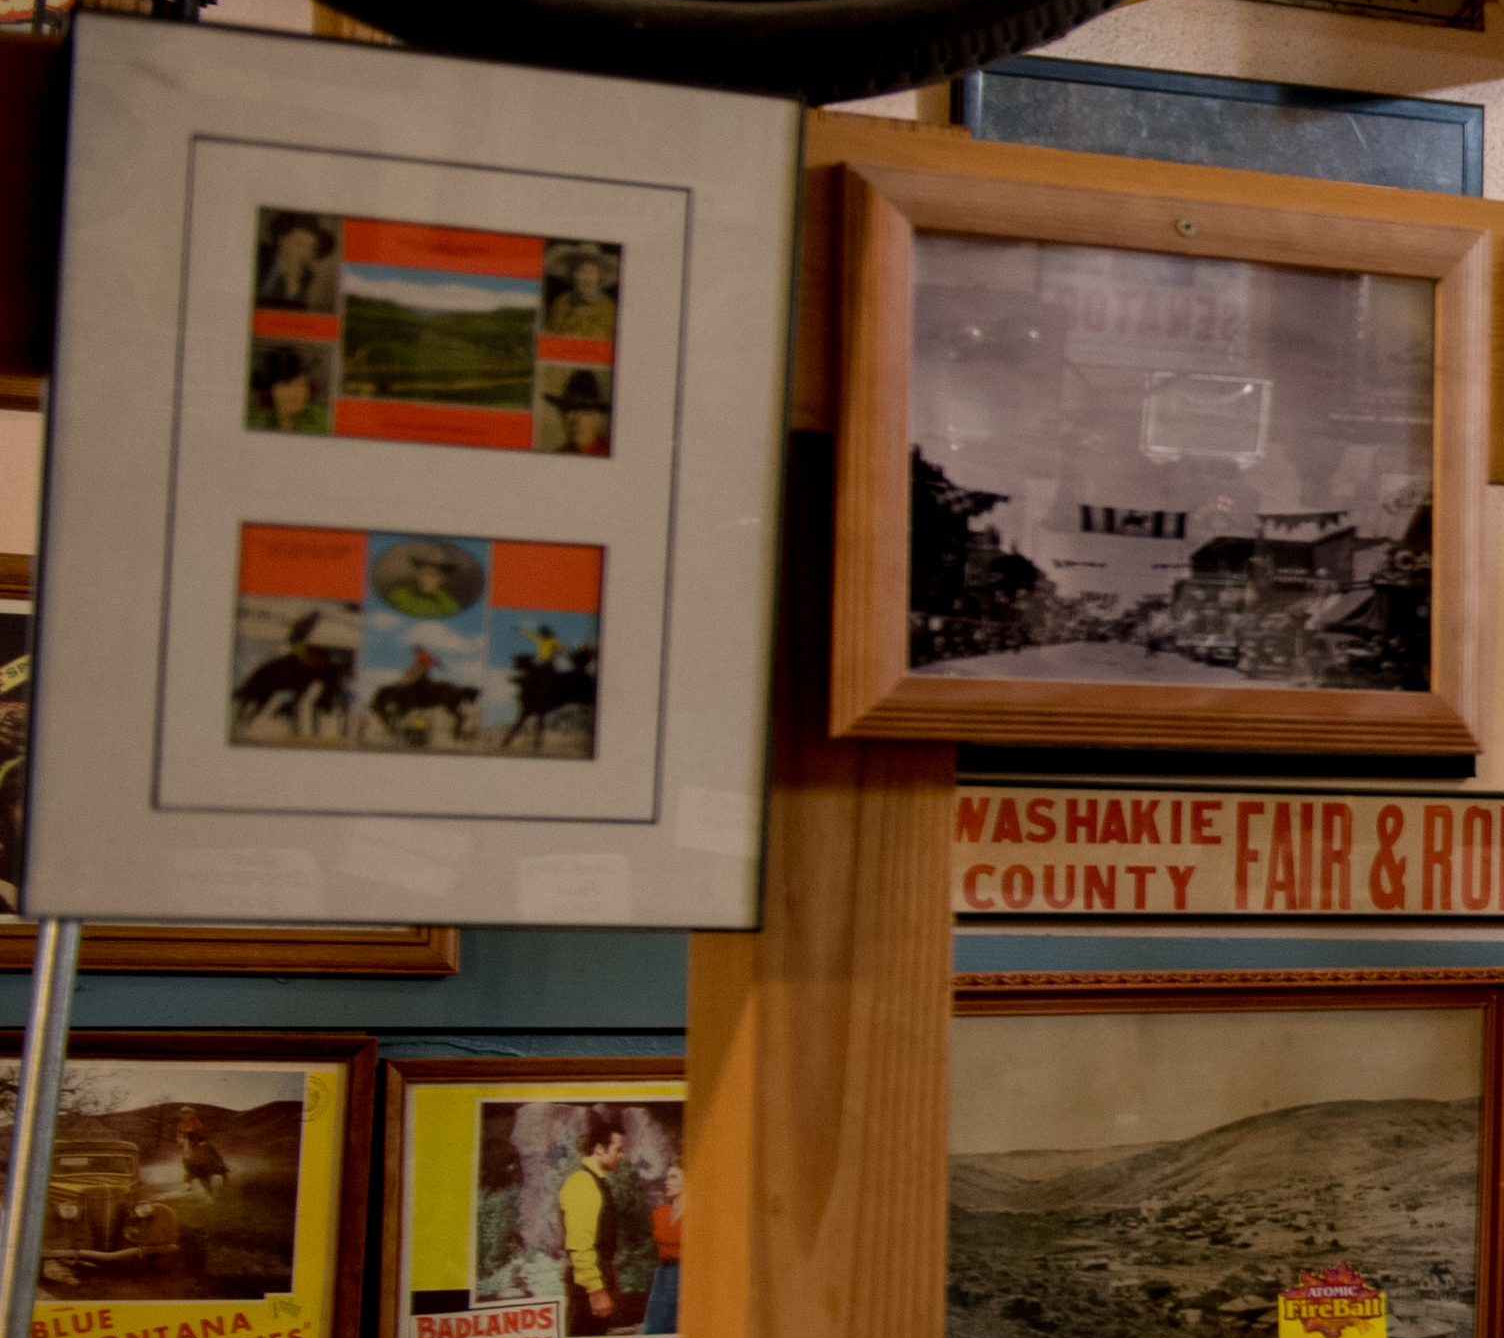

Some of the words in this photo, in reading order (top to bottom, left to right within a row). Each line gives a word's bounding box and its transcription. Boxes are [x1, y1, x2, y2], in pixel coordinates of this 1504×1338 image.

[1235, 801, 1353, 910] FAIR
[1369, 804, 1406, 910] &
[963, 864, 1196, 910] COUNTY
[1307, 1284, 1358, 1299] ATOMIC
